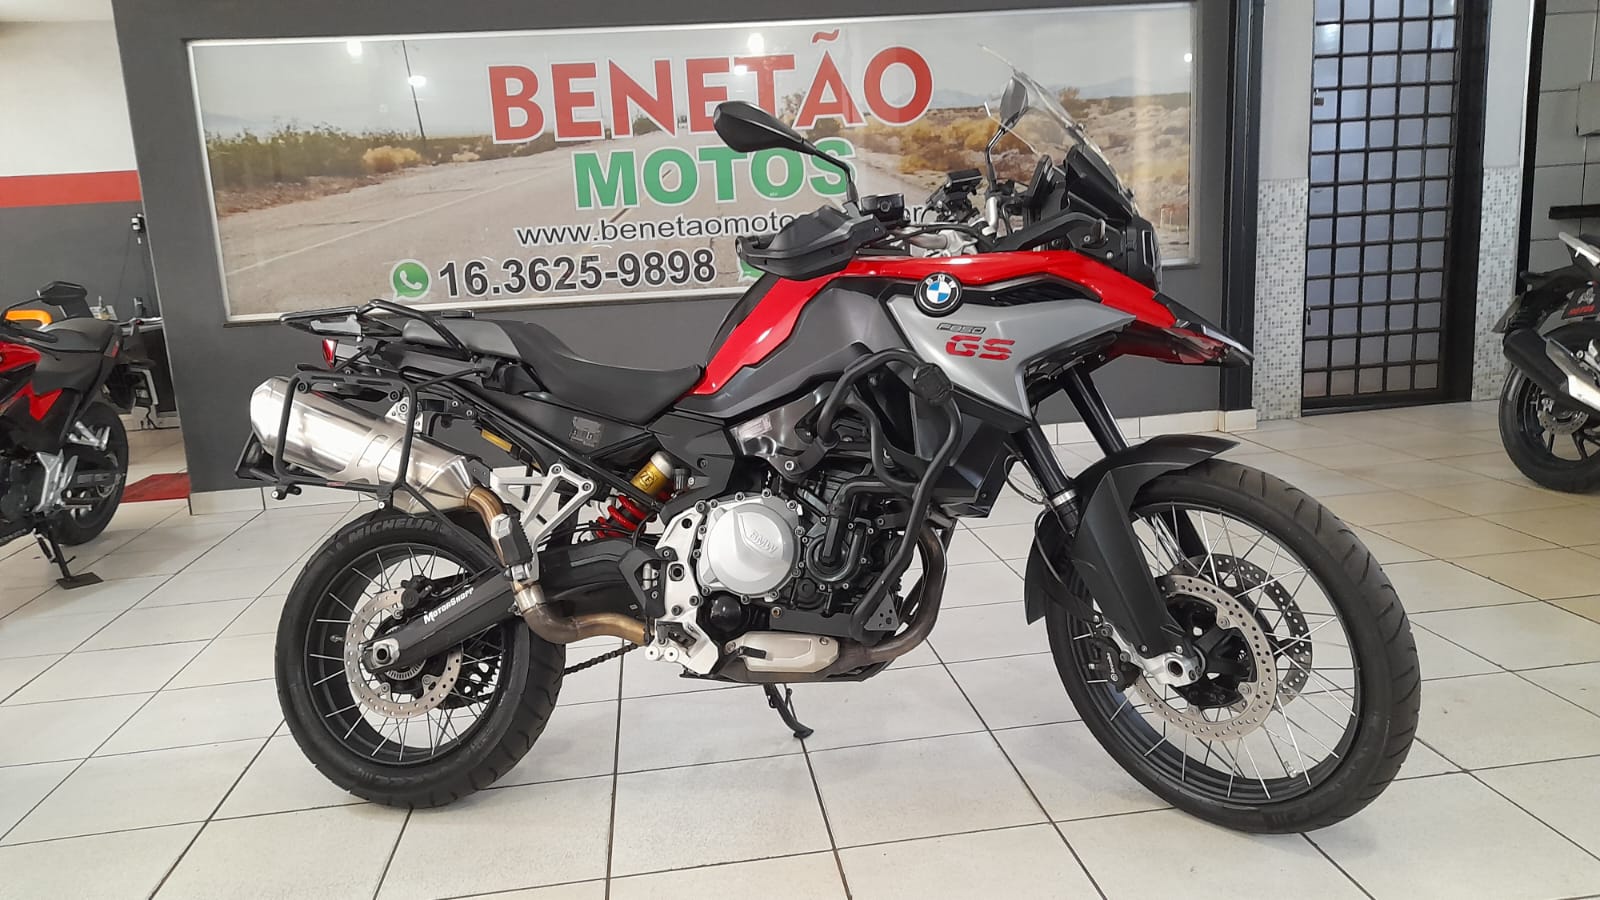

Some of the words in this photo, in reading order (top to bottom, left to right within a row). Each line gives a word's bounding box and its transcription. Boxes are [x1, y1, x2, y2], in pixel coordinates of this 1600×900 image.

[488, 28, 933, 142] BENETÃO
[573, 139, 855, 208] MOTOS
[439, 249, 715, 297] 16.3625-9898
[925, 274, 957, 290] BMW
[945, 335, 1016, 360] GS
[349, 517, 440, 544] MICHELIN
